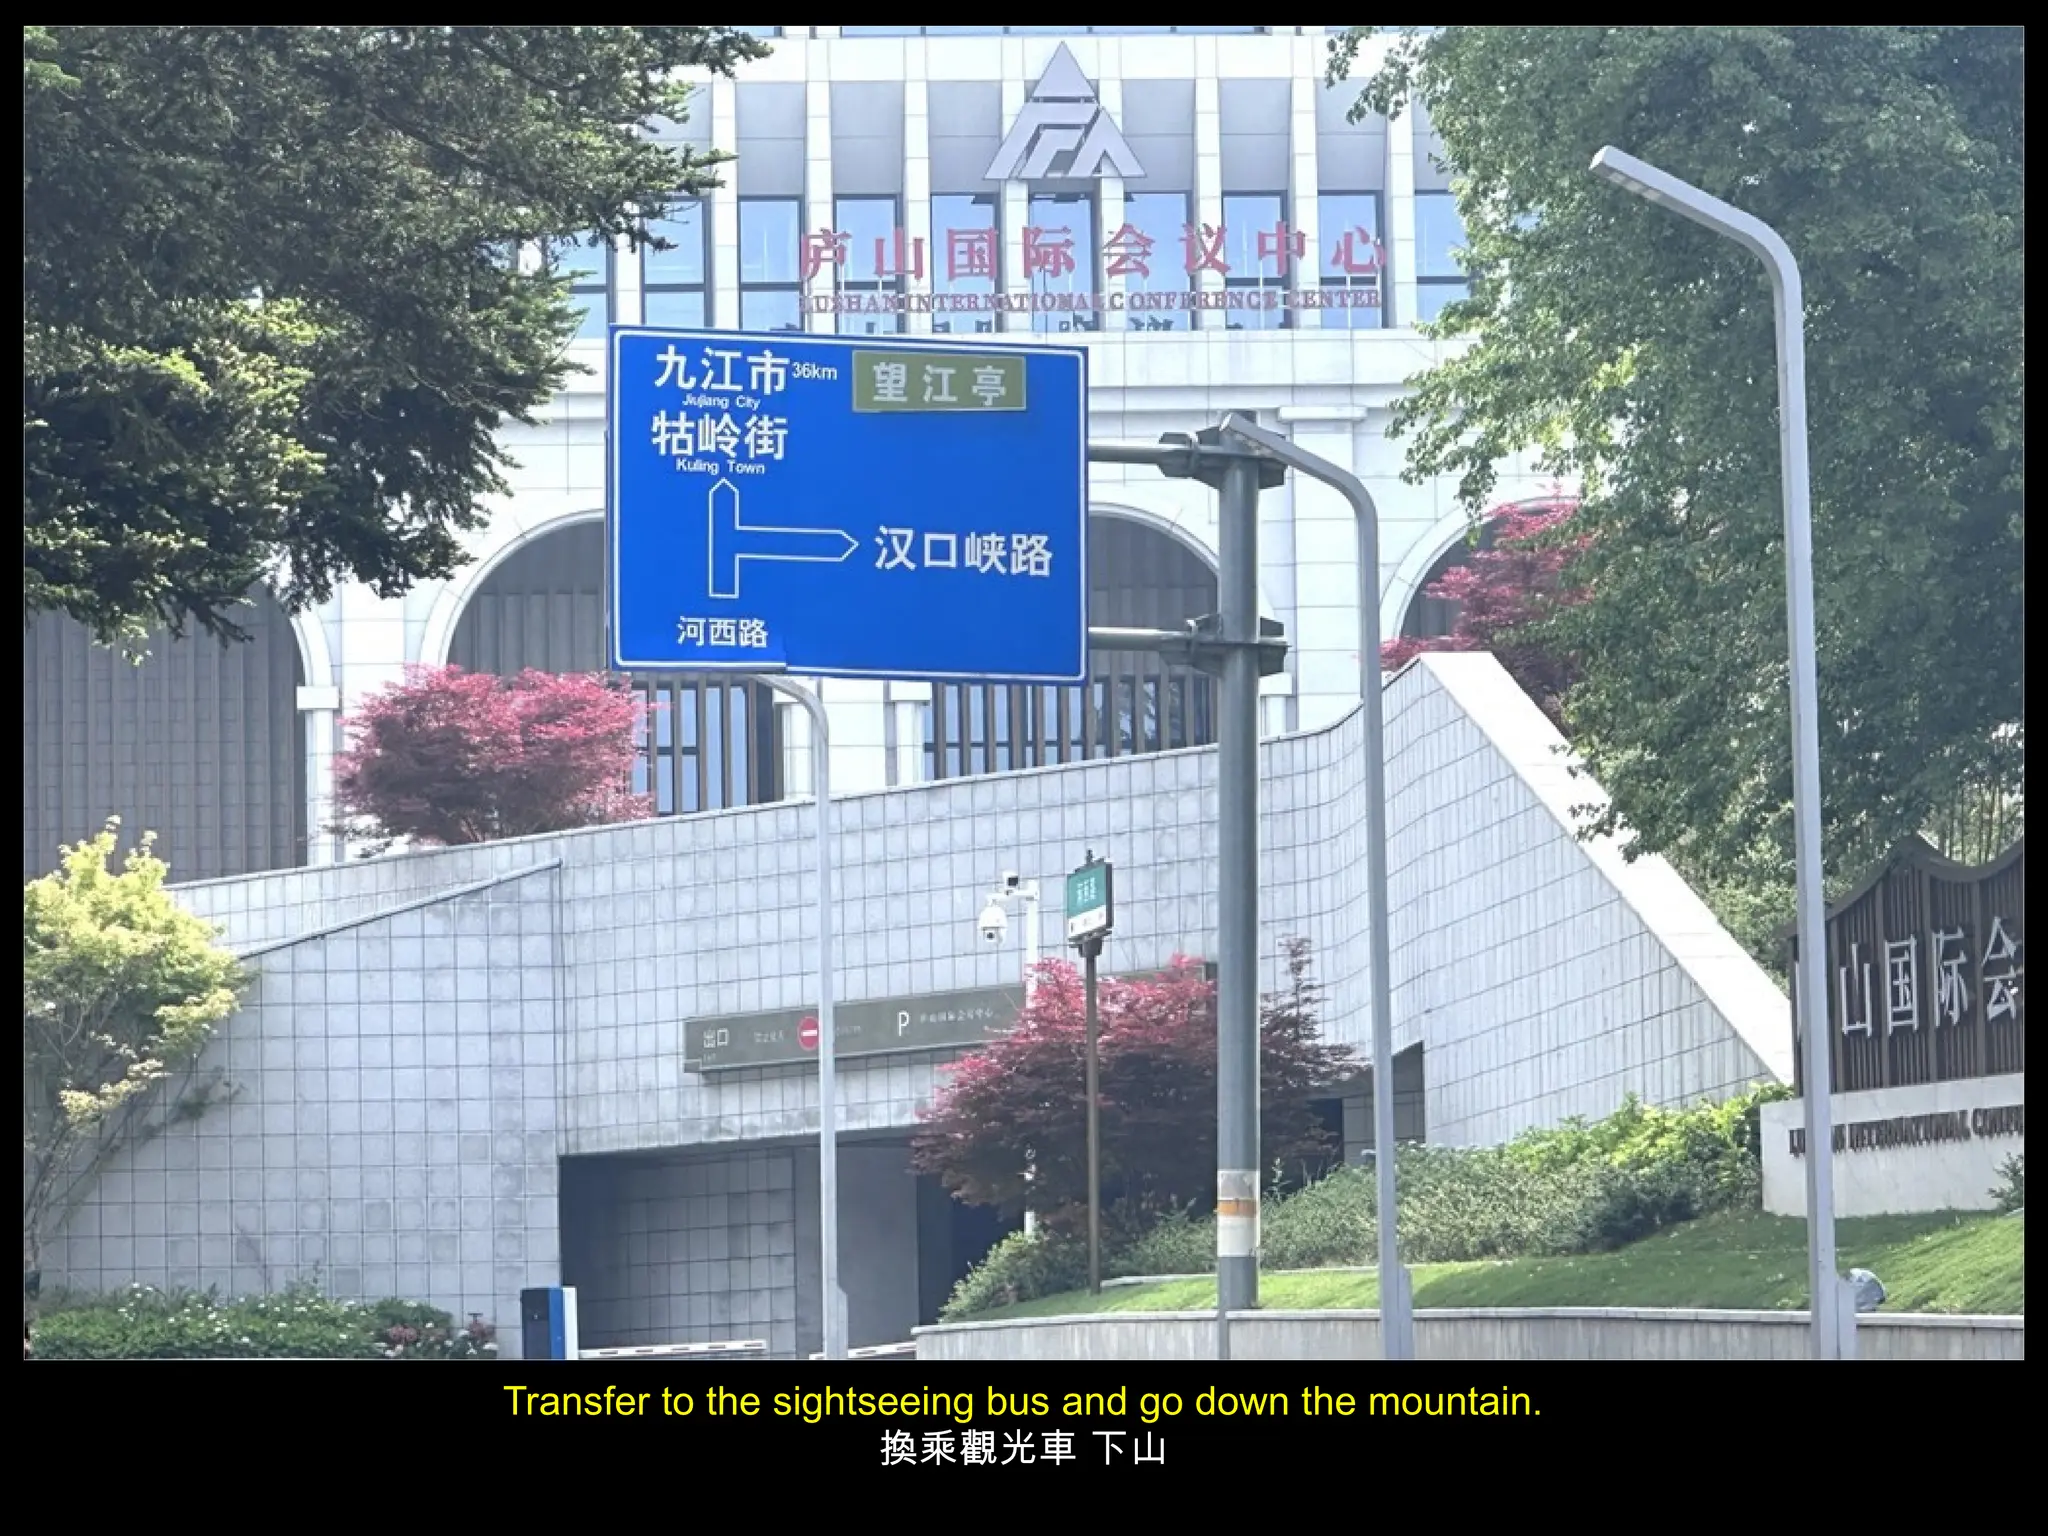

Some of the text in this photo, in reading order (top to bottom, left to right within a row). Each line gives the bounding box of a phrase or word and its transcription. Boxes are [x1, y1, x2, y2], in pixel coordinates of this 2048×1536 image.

[800, 221, 1385, 281] 庐山国际会议中心
[1109, 291, 1279, 311] CONFERENCE
[1286, 289, 1380, 309] CENTER
[654, 345, 838, 395] 九江市 36km
[873, 361, 1007, 406] 望江亭
[682, 393, 761, 411] Jiujiang City
[652, 410, 788, 460] 牯岭街
[675, 458, 765, 475] Kuling Town
[875, 525, 1053, 577] 汉口峡路
[677, 615, 768, 648] 河西路
[1795, 916, 2024, 1038] 山国际会
[703, 1027, 730, 1048] 出口
[898, 1010, 910, 1037] P
